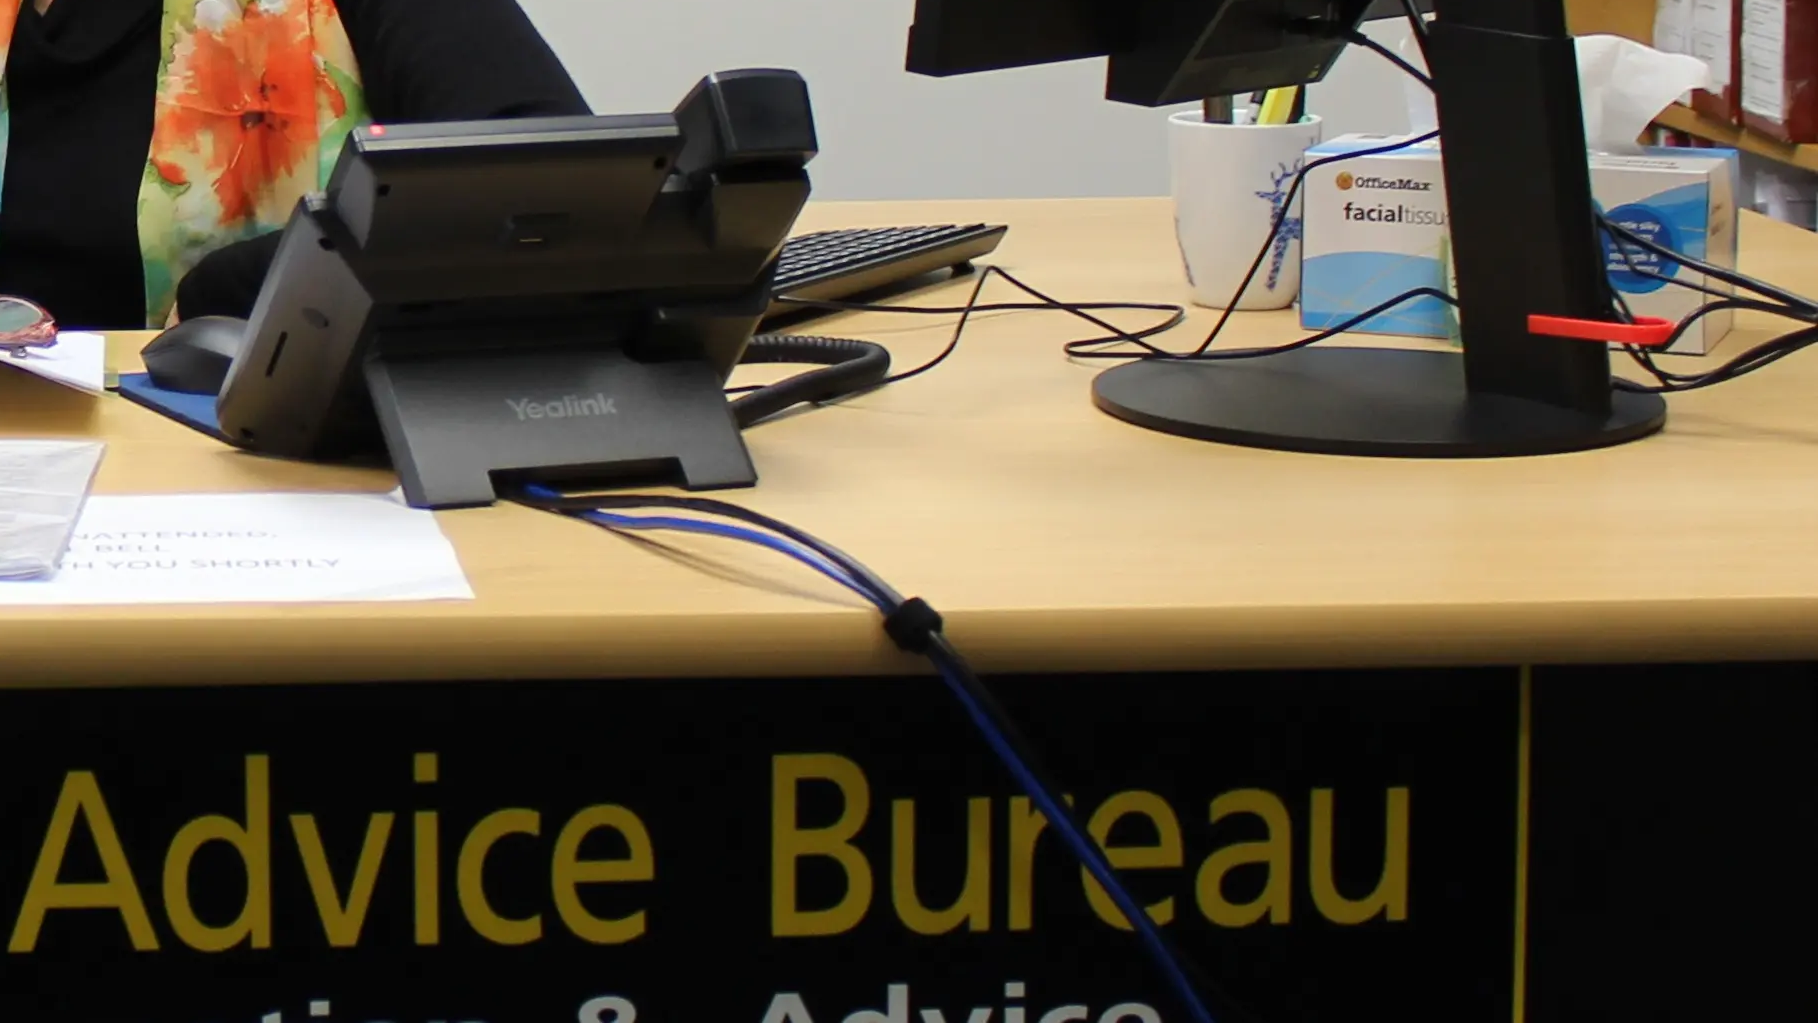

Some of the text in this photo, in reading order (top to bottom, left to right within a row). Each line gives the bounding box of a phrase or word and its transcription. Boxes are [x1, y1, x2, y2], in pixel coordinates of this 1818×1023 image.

[1355, 176, 1433, 191] OfficeMax
[1344, 202, 1449, 226] facialtissu
[504, 393, 618, 421] Yealink
[95, 544, 170, 553] BELL
[108, 559, 340, 570] YOU SHORTLY
[2, 750, 658, 954] Advice
[766, 750, 1414, 942] Bureau
